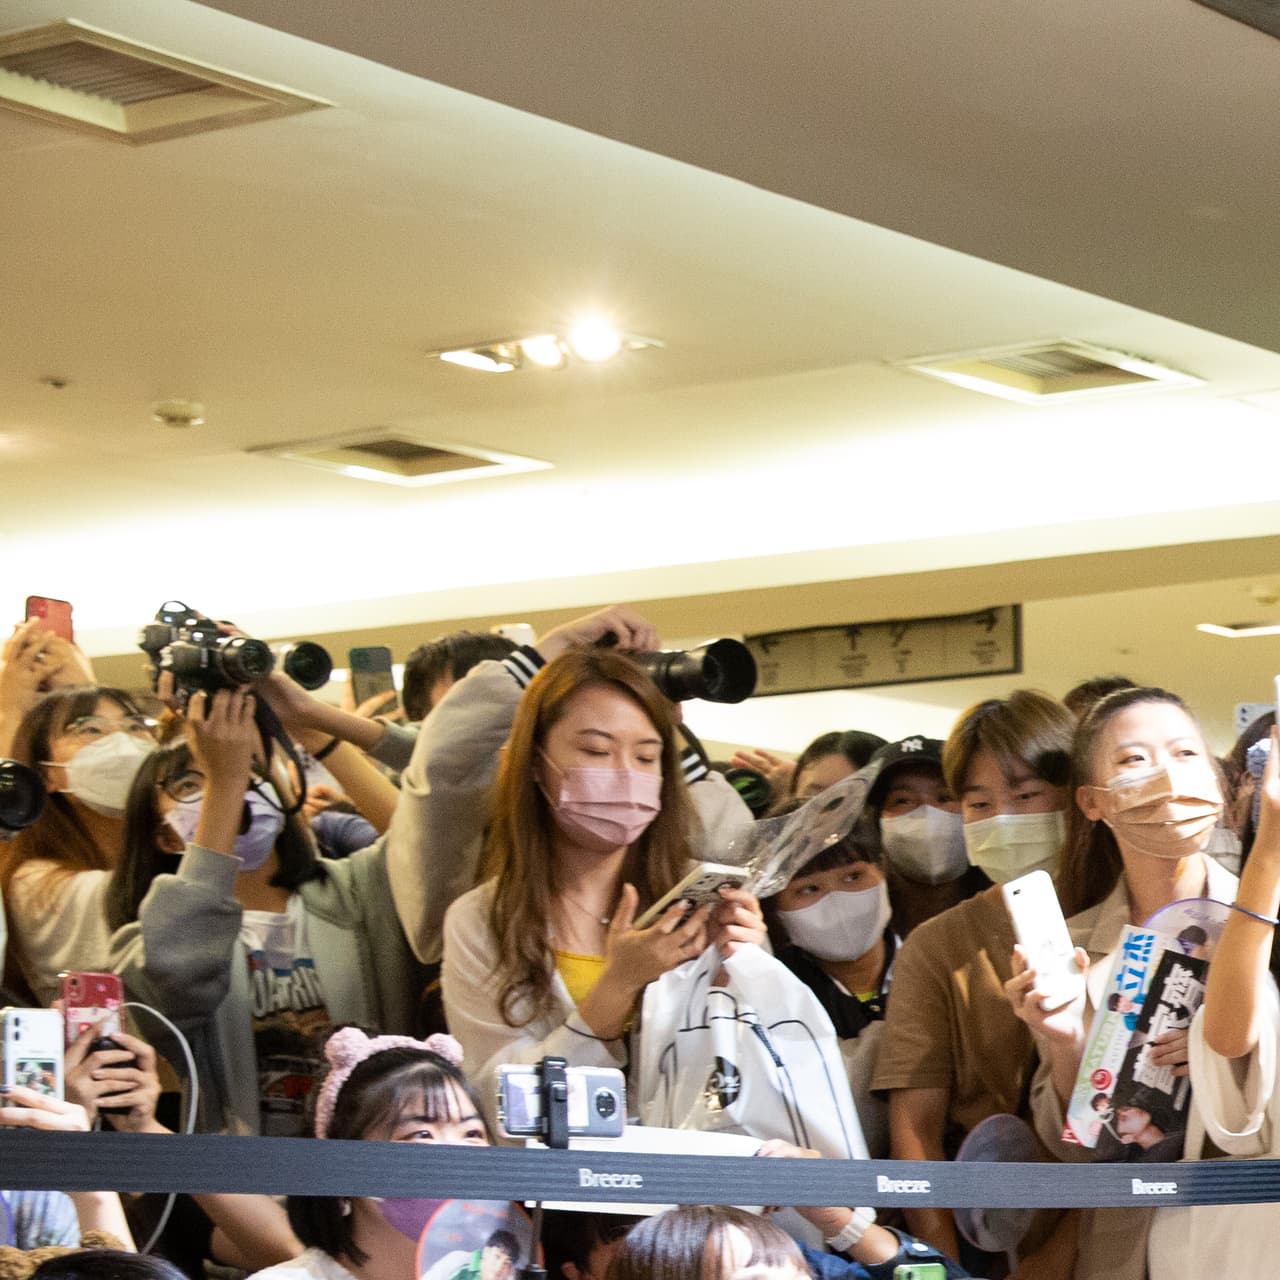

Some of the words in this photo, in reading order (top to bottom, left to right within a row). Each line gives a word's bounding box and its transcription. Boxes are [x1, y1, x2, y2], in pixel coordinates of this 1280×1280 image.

[578, 1168, 643, 1189] Breeze
[876, 1174, 931, 1194] Breeze
[1131, 1178, 1178, 1196] Breeze
